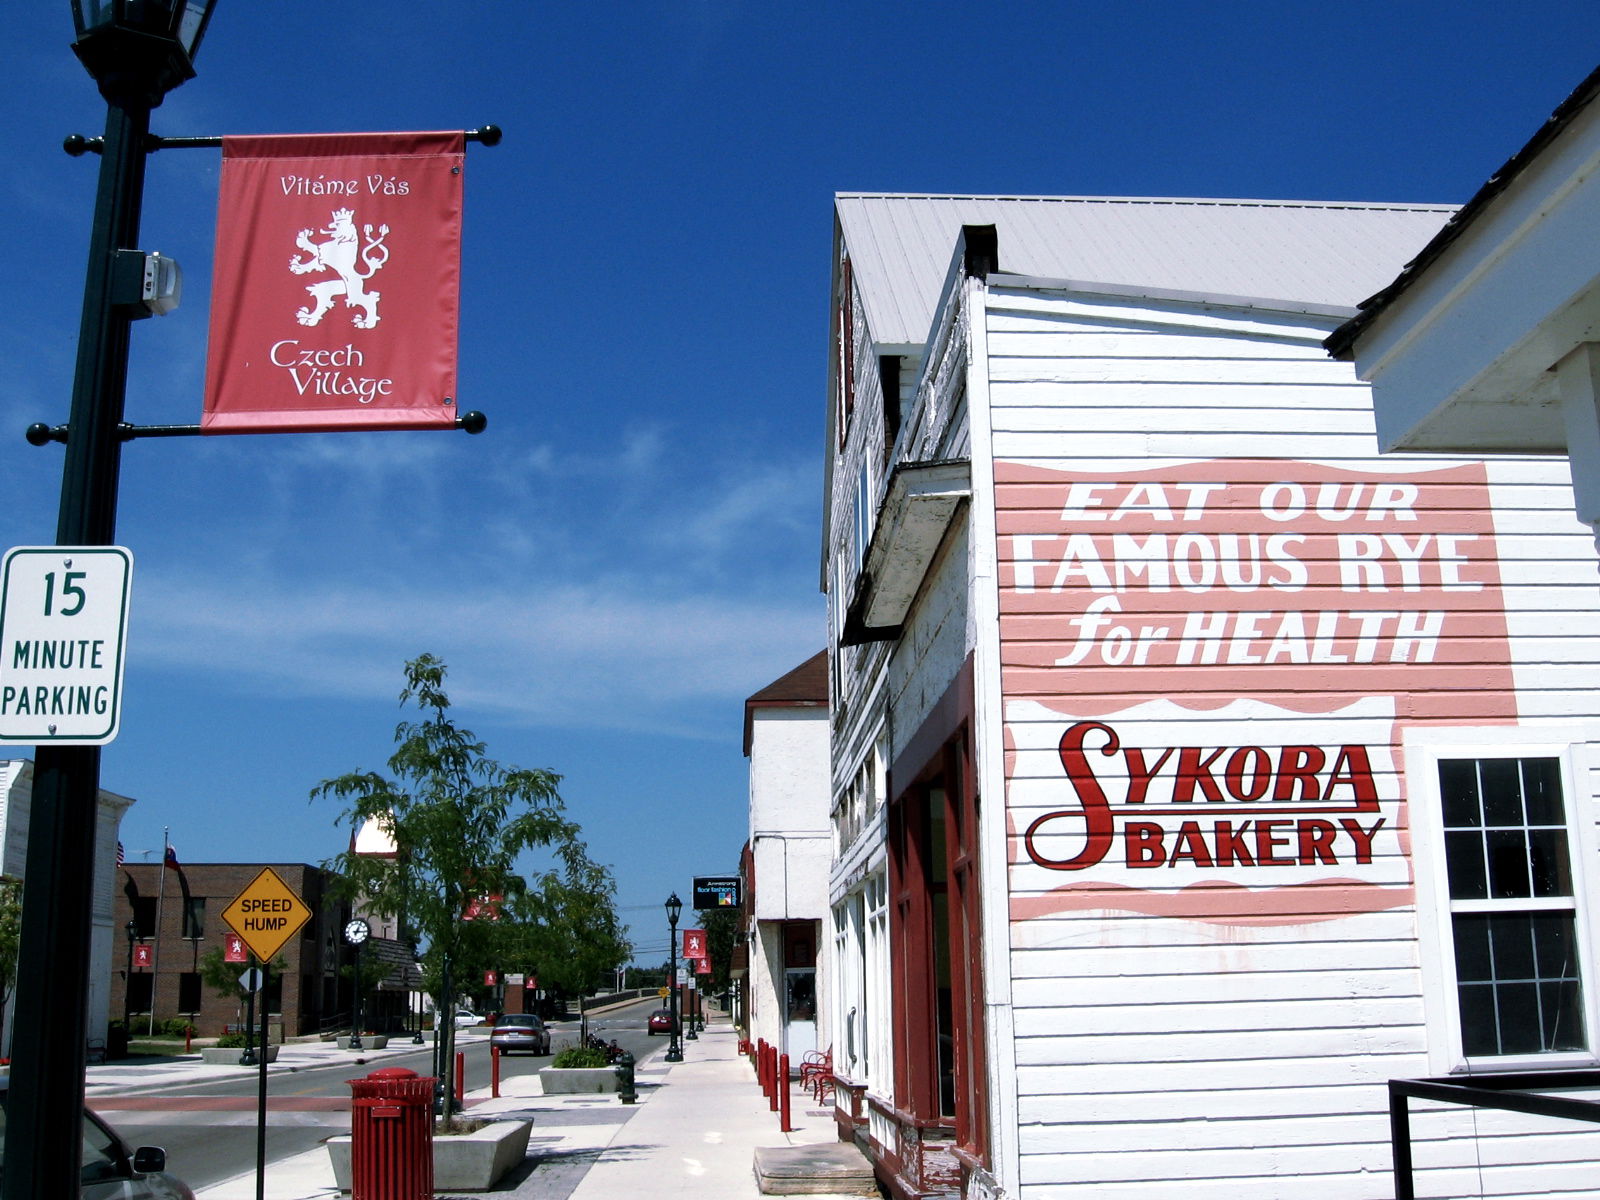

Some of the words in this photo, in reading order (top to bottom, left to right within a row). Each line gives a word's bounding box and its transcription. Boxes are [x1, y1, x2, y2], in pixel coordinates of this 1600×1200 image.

[366, 174, 410, 195] Vás
[270, 340, 364, 367] Czech
[288, 367, 393, 404] Village
[1060, 481, 1228, 522] EAT
[1258, 481, 1419, 522] OUR
[1012, 532, 1308, 594] FAMOUS
[1338, 532, 1485, 593] RYE
[44, 571, 87, 617] 15
[1055, 594, 1169, 666] for
[1176, 609, 1445, 665] HEALTH
[13, 640, 105, 670] MINUTE
[1, 686, 108, 715] PARKING
[1025, 721, 1382, 871] SYKORA
[1125, 817, 1387, 869] BAKERY
[241, 899, 292, 913] SPEED
[244, 917, 288, 931] HUMP
